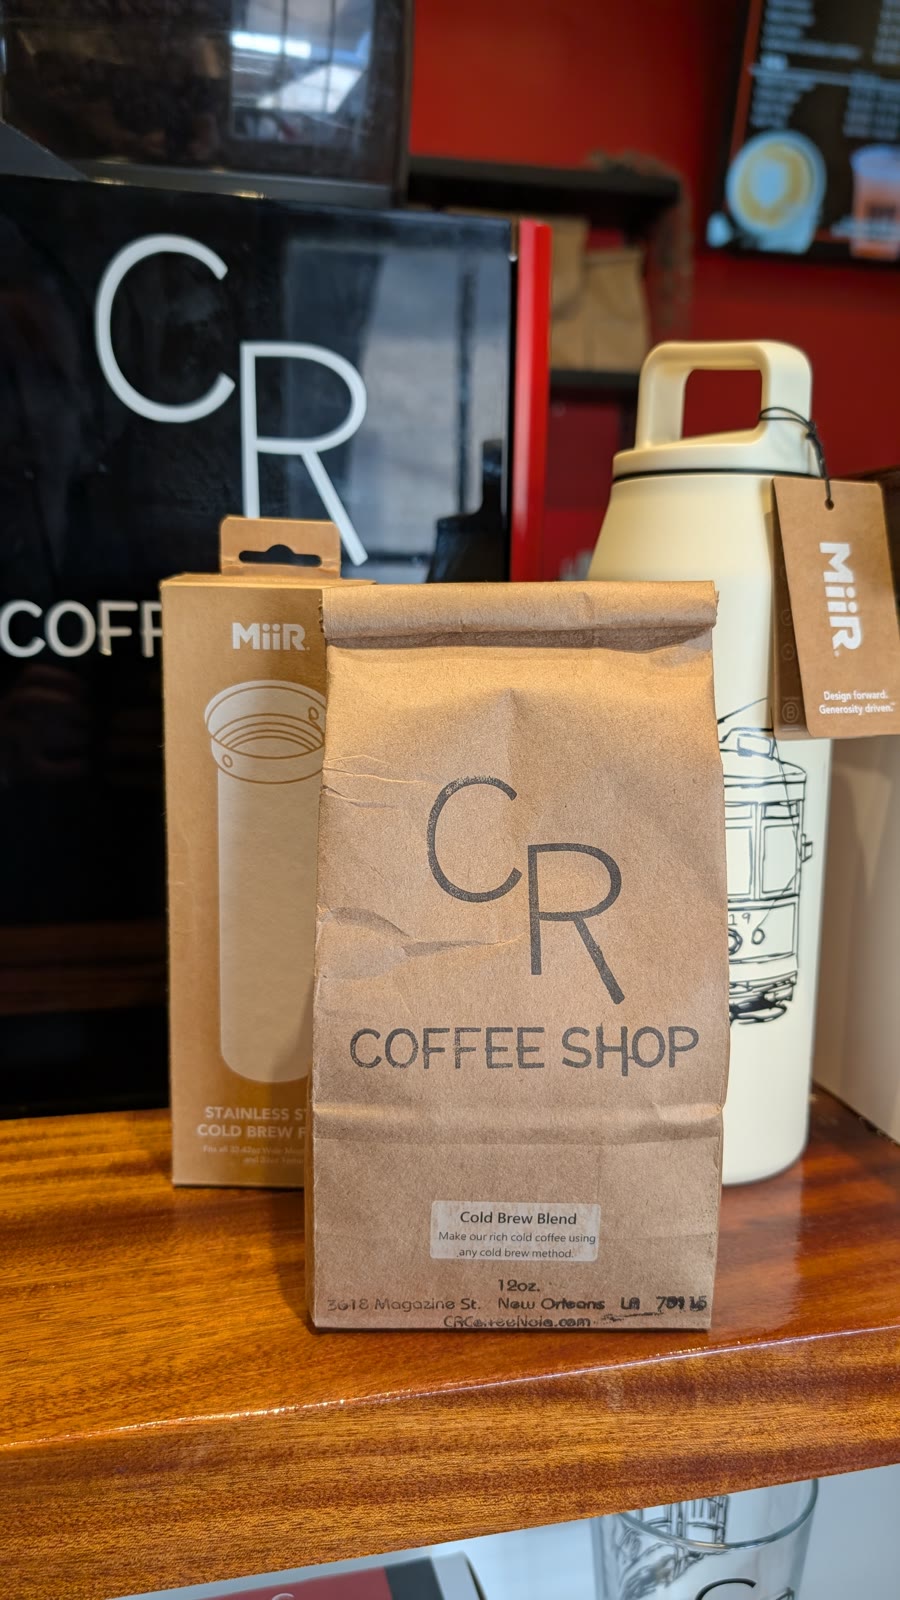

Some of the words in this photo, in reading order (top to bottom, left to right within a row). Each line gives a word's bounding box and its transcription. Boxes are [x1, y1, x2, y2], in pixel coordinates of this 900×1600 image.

[818, 542, 862, 657] MiiR
[232, 622, 309, 651] MiiR
[823, 690, 852, 703] Design
[853, 689, 889, 700] forward.
[819, 704, 863, 716] Generosity
[350, 1027, 545, 1069] COFFEE
[561, 1023, 699, 1077] SHOP
[205, 1106, 289, 1121] STAINLESS
[197, 1124, 241, 1137] COLD
[247, 1126, 293, 1138] BREW
[460, 1211, 493, 1223] Cold
[497, 1212, 533, 1224] Brew
[537, 1213, 577, 1225] Blend
[438, 1231, 467, 1241] Make
[469, 1233, 487, 1242] our
[489, 1232, 508, 1242] rich
[510, 1232, 533, 1242] cold
[535, 1232, 567, 1243] coffee
[569, 1233, 596, 1245] using
[459, 1249, 477, 1259] any
[479, 1248, 501, 1257] cold
[504, 1248, 531, 1258] brew
[532, 1249, 574, 1259] method.
[498, 1279, 541, 1292] 12oz.
[374, 1298, 455, 1313] Magazine
[460, 1298, 481, 1310] St.
[498, 1298, 536, 1310] New
[541, 1298, 605, 1310] Orleans
